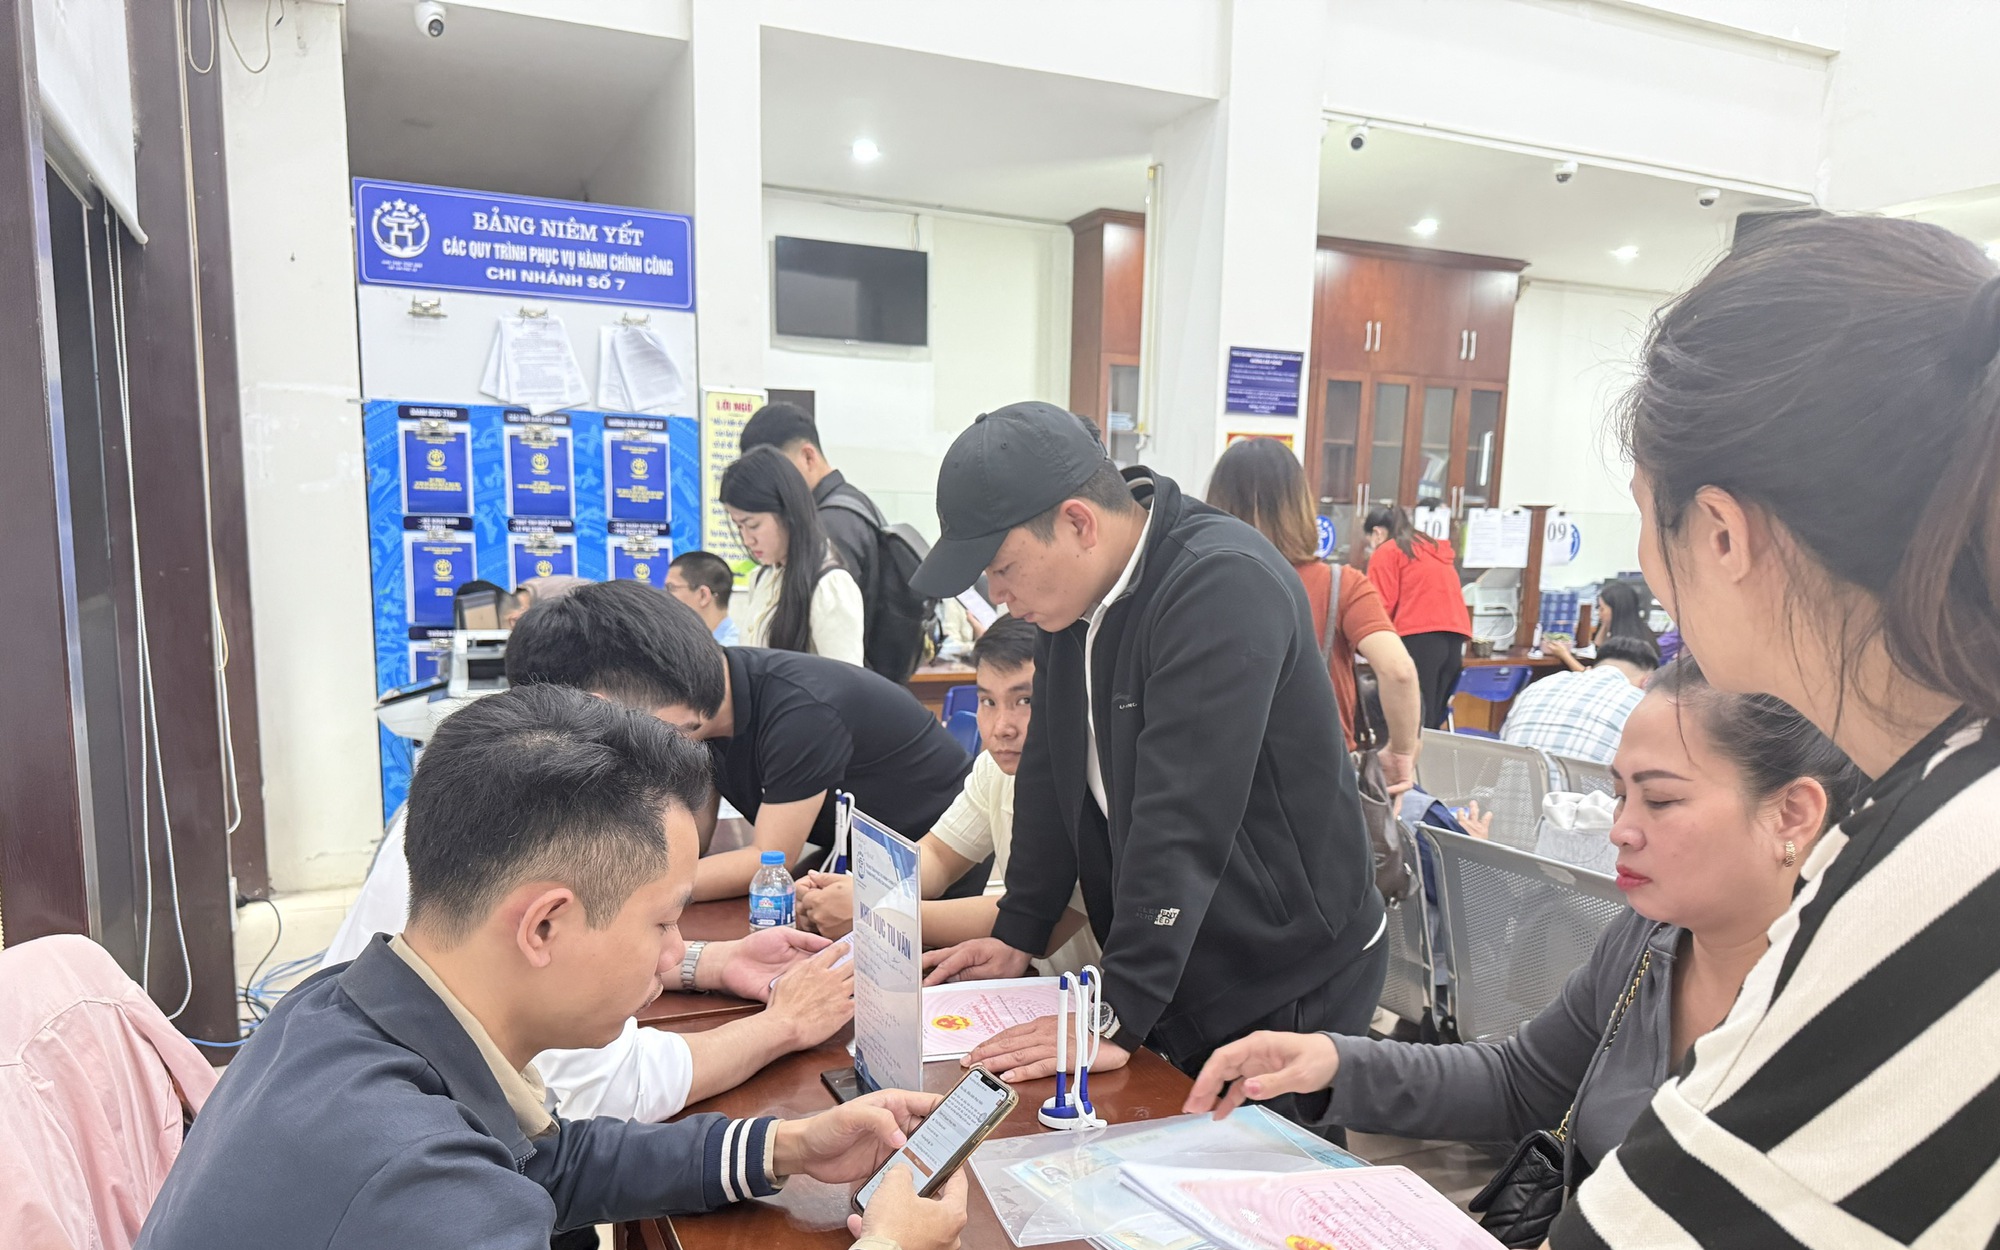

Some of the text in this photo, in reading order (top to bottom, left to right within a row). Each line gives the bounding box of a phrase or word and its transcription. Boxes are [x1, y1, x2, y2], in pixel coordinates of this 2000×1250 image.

[472, 206, 644, 246] BẢNG NIÊM YẾT
[442, 236, 673, 276] CÁC QUY TRÌNH PHỤC VỤ HÀNH CHÍNH CÔNG
[486, 266, 626, 291] CHI NHÁNH SỐ 7
[1424, 519, 1442, 539] 10
[1547, 521, 1567, 542] 09
